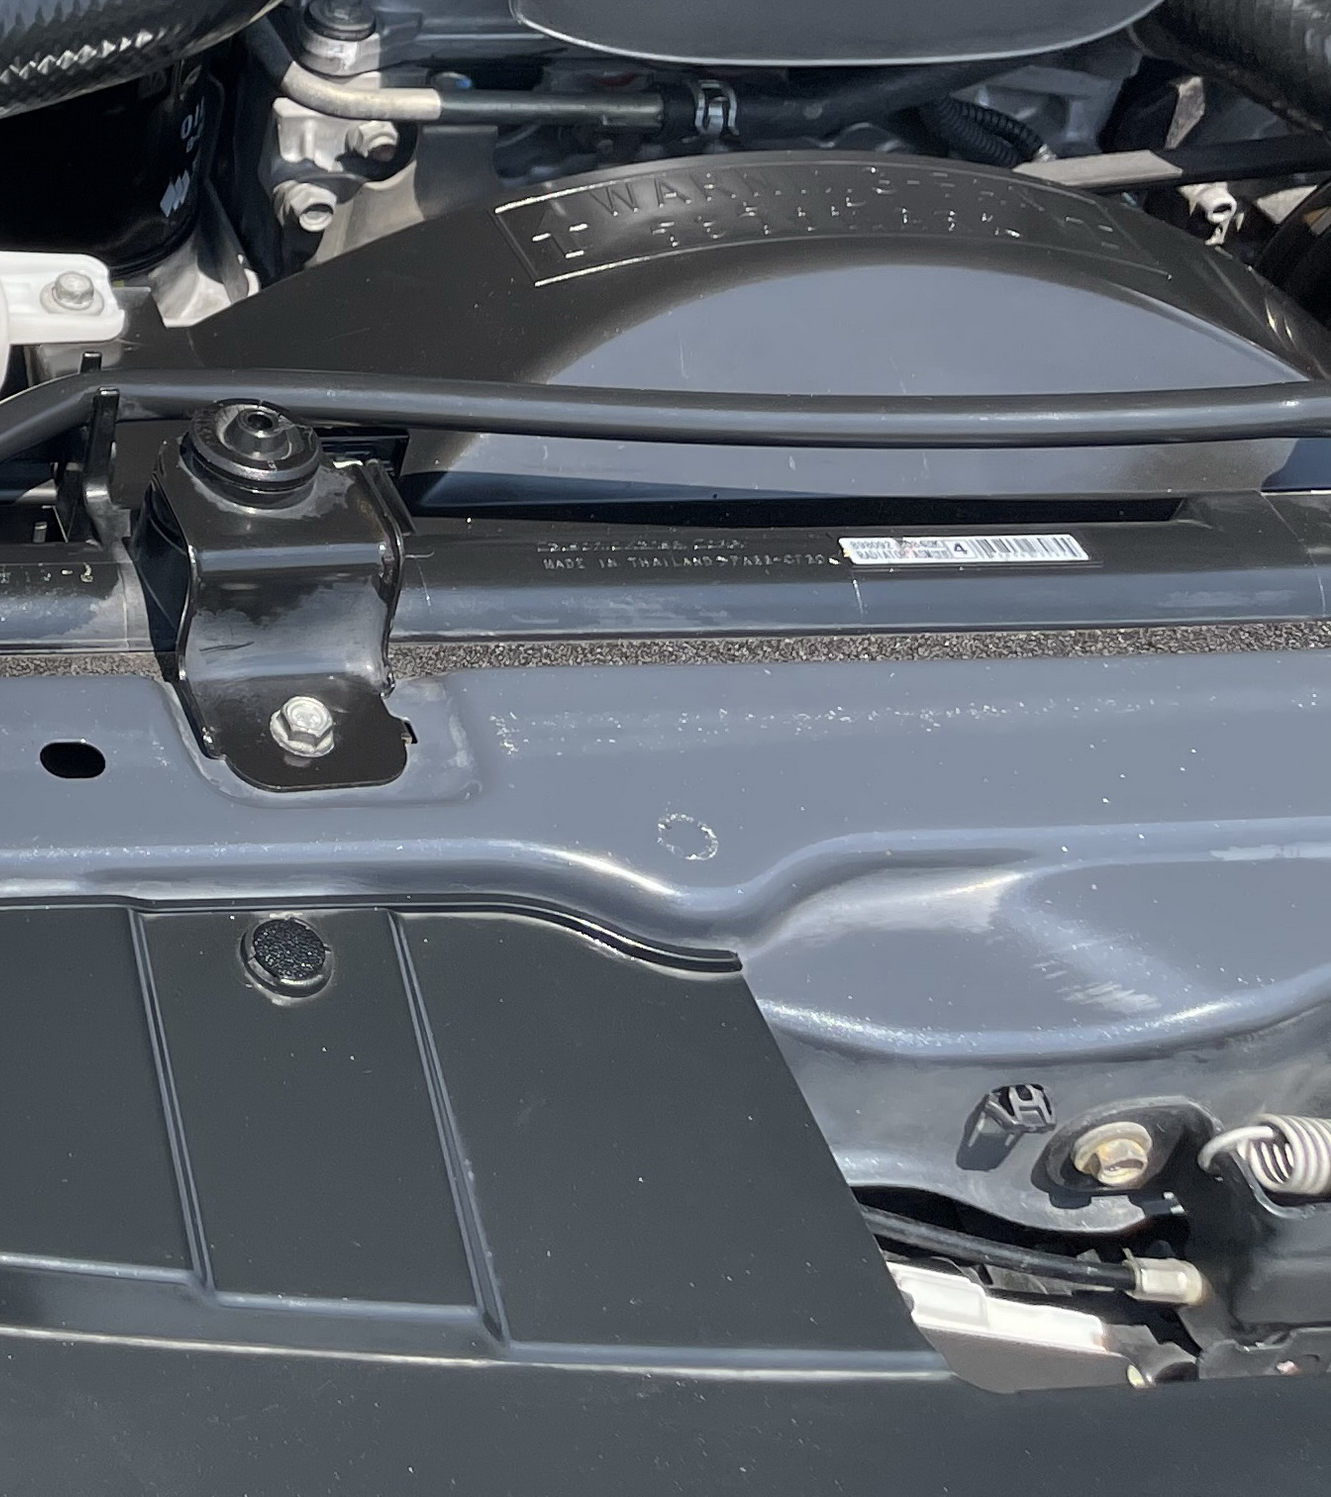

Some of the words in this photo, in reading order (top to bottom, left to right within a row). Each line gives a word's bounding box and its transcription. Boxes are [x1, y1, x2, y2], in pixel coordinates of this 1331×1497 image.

[953, 541, 969, 555] 4
[541, 556, 587, 570] MADE
[598, 556, 619, 570] IN
[626, 553, 714, 569] THAILAND
